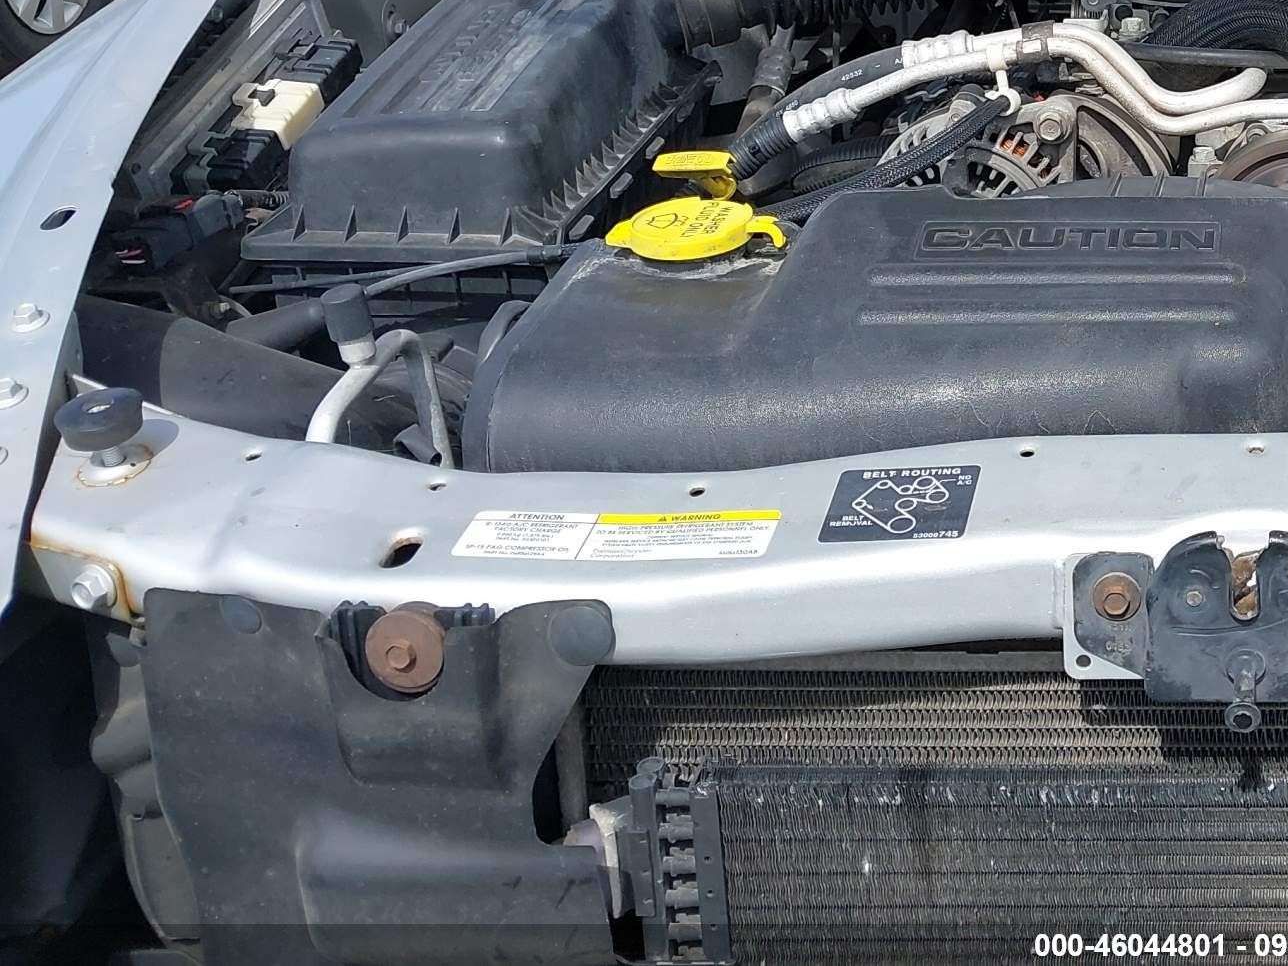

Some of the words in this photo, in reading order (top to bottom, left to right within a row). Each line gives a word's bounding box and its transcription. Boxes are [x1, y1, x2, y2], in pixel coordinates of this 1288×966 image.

[696, 202, 719, 222] FLUID
[704, 206, 734, 234] WASHER
[921, 227, 1216, 251] CAUTION
[863, 470, 896, 479] BELT
[901, 468, 961, 477] ROUTING
[672, 514, 721, 522] WARNING
